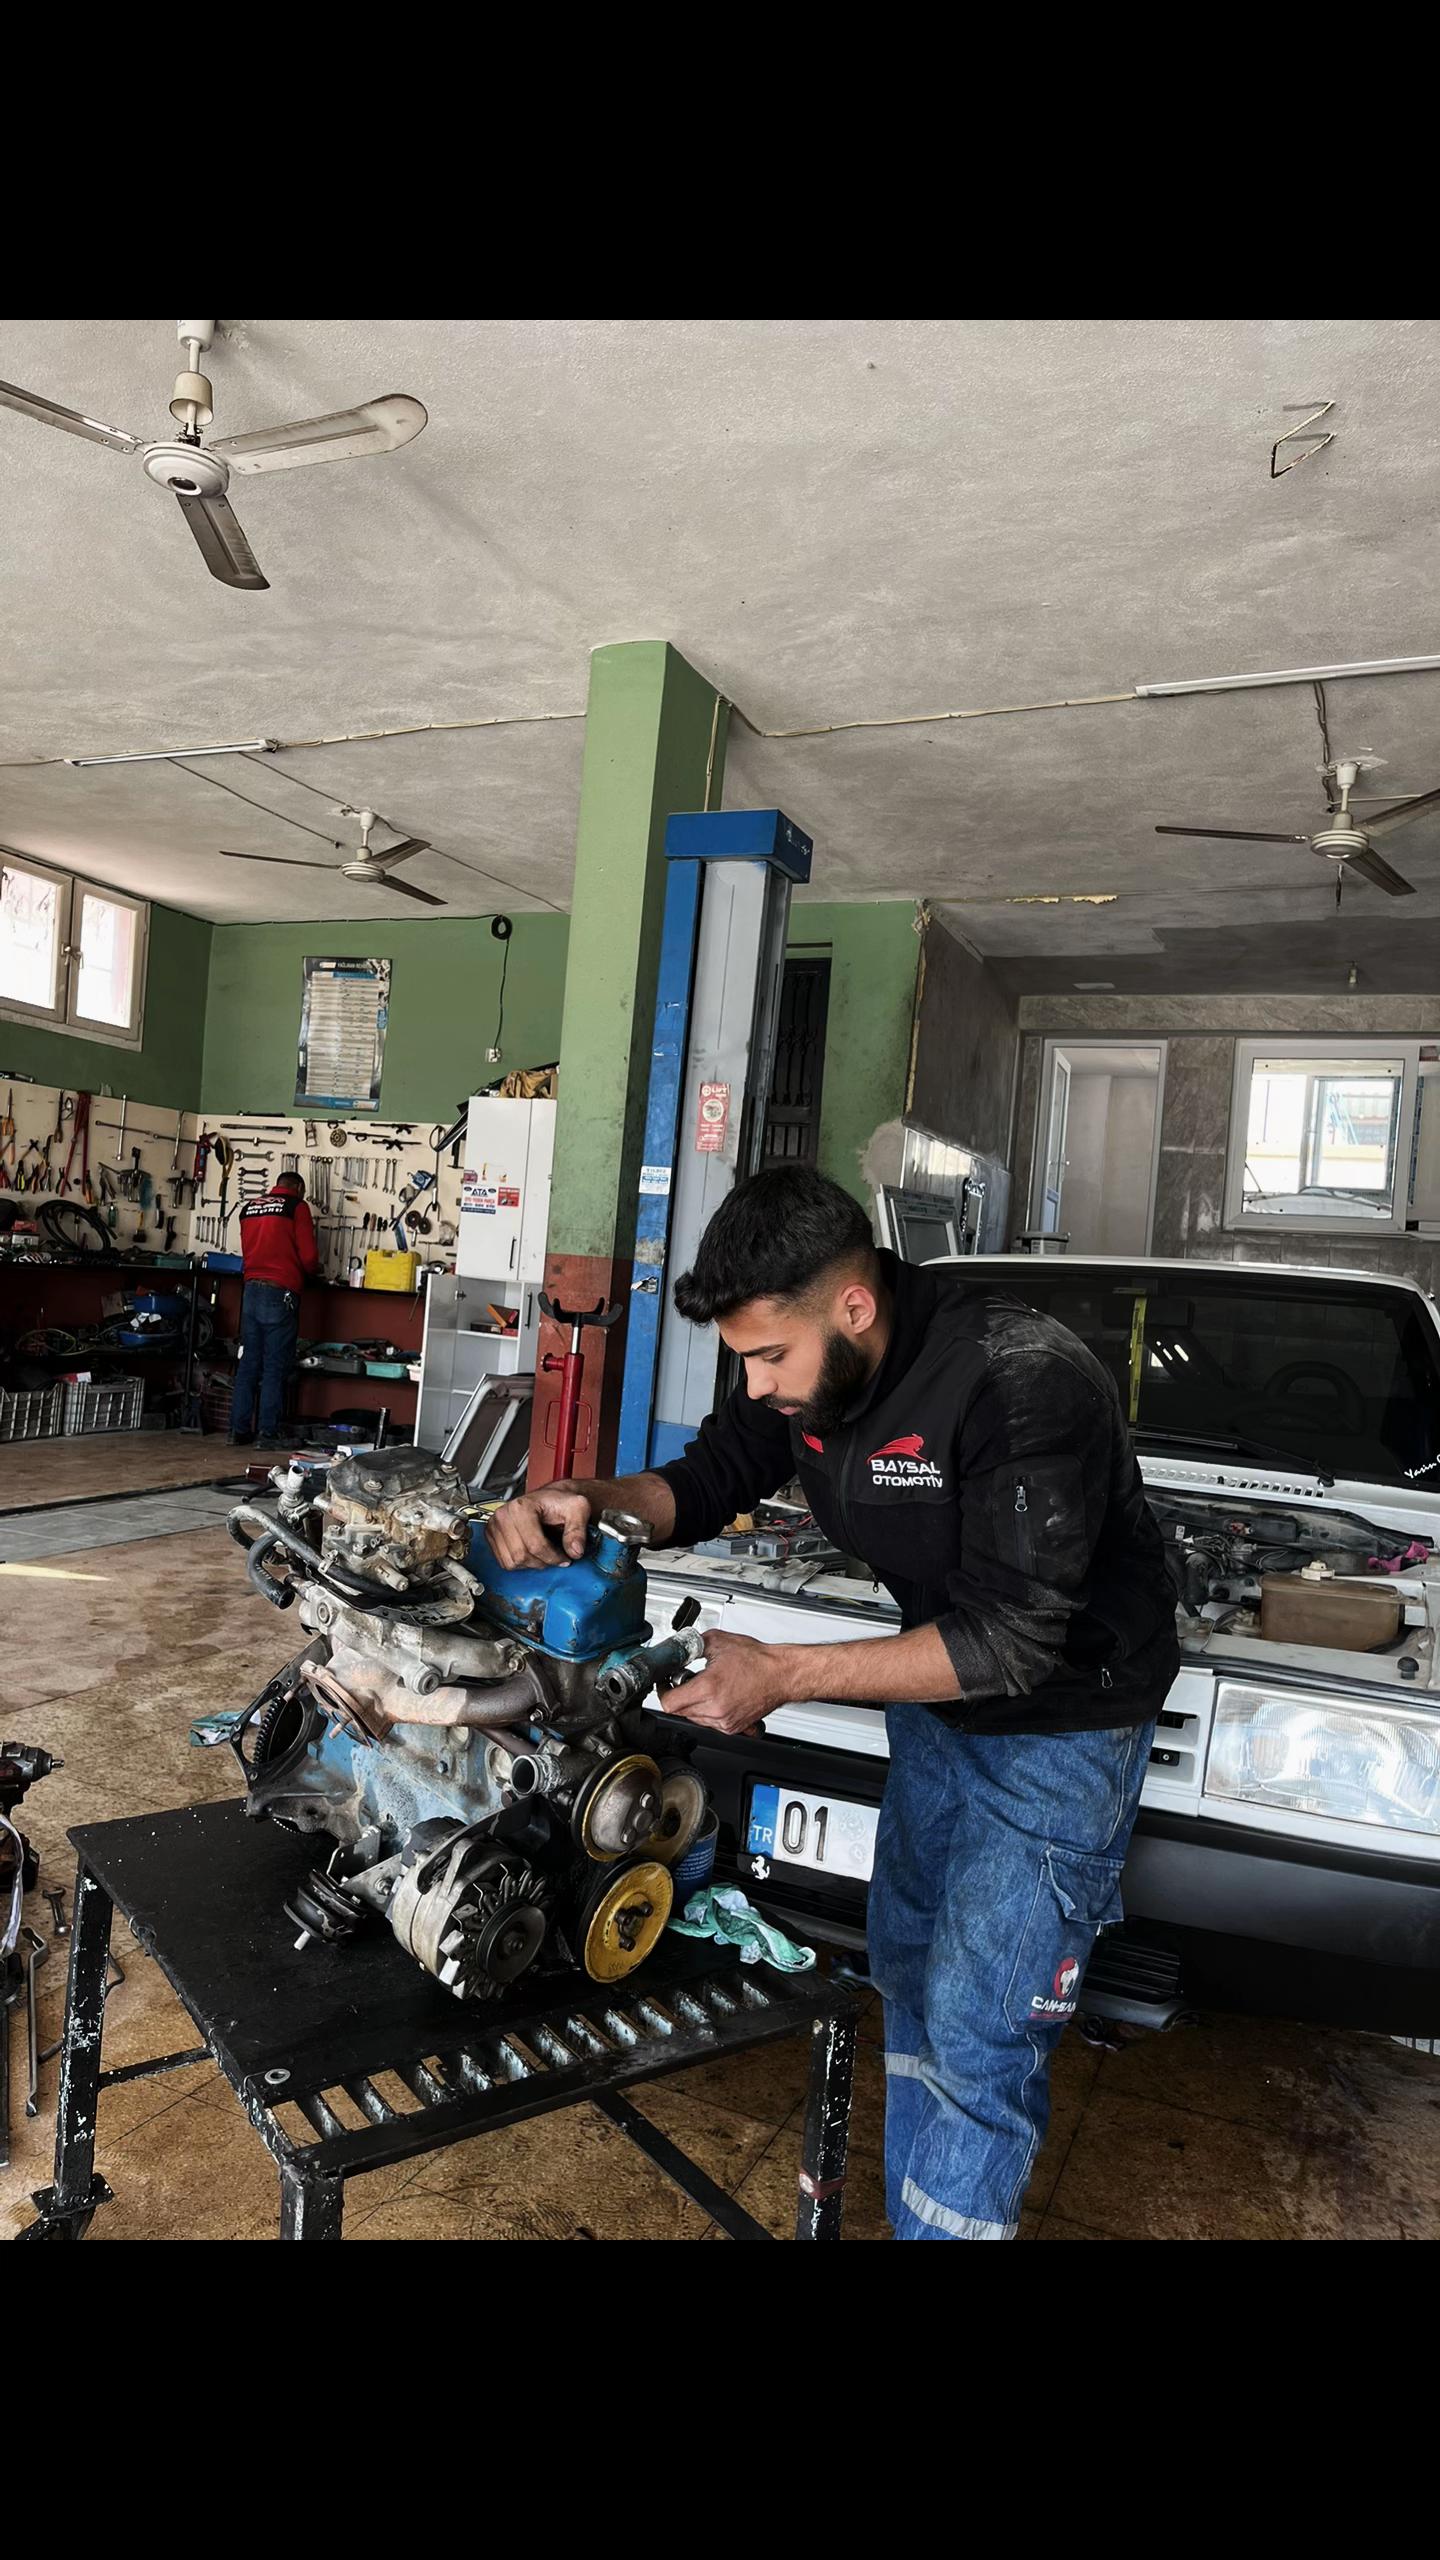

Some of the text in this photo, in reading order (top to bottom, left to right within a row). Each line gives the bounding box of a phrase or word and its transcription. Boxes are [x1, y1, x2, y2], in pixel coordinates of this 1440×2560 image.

[471, 1188, 488, 1197] ATA
[871, 1459, 941, 1475] BAYSAL
[751, 1800, 829, 1862] TR 01
